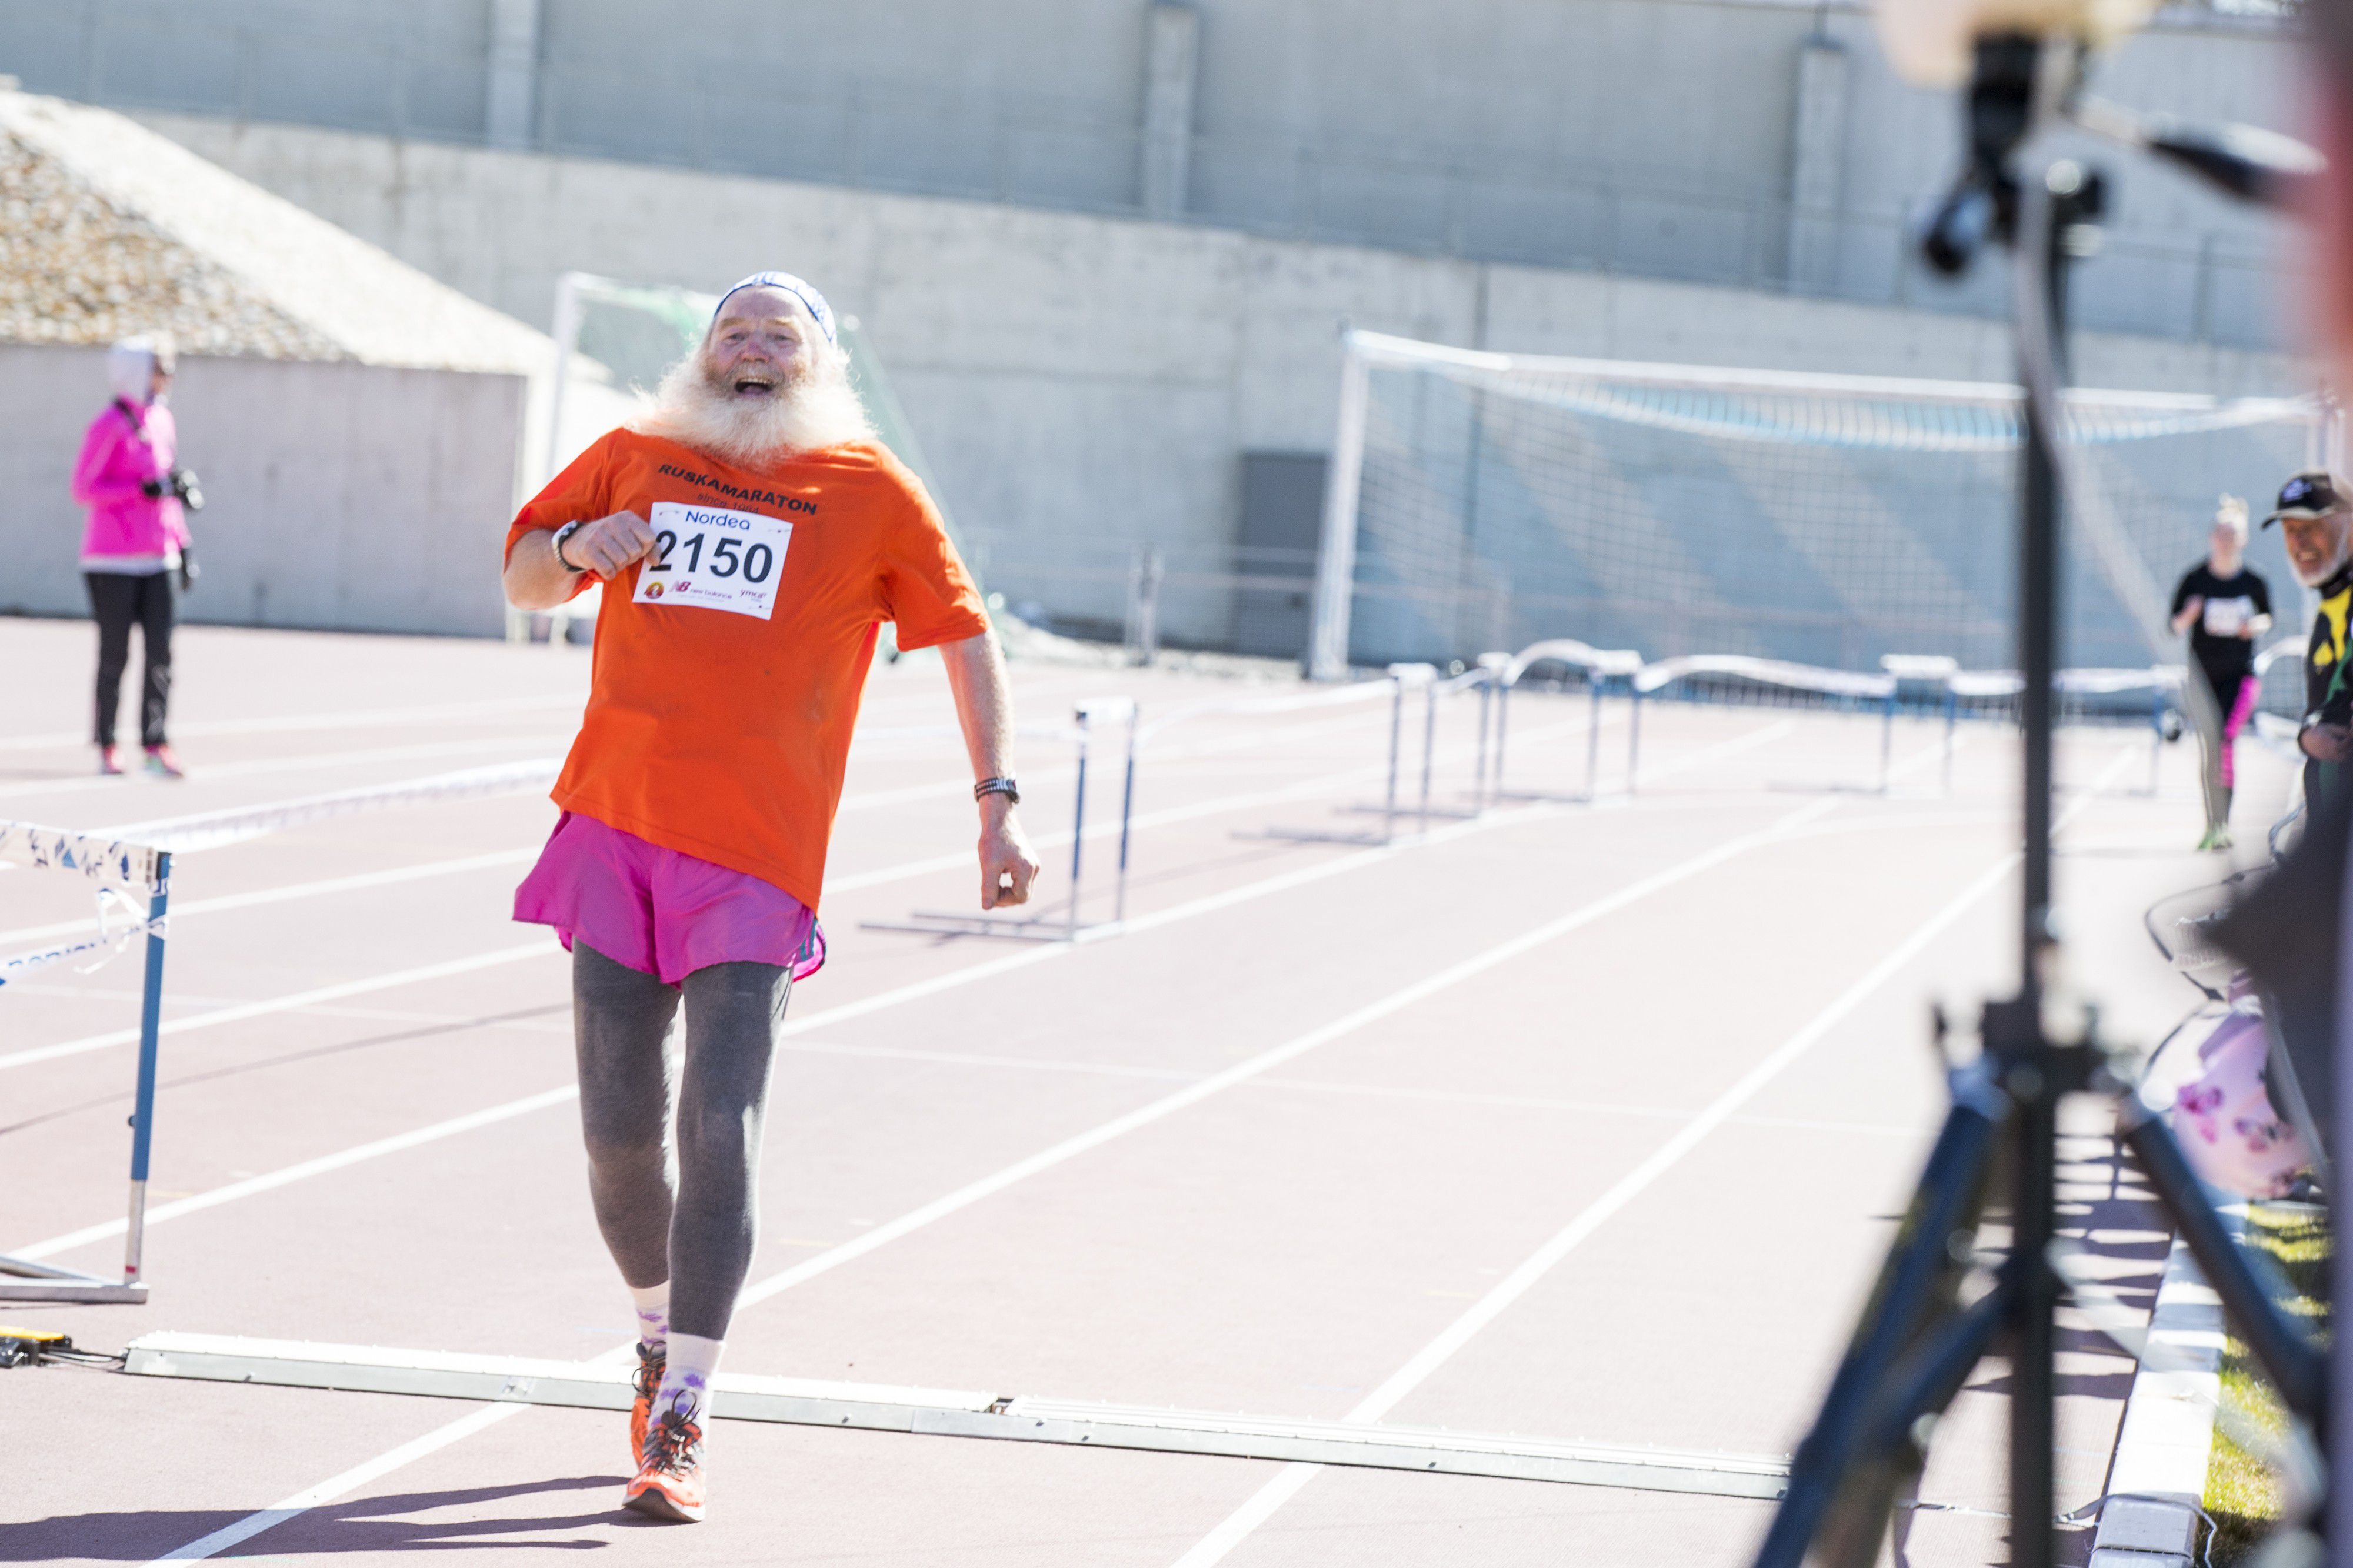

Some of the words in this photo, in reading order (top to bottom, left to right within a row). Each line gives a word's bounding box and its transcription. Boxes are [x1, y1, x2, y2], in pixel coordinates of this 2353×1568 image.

[658, 464, 818, 515] RUSKAMARATON
[685, 510, 751, 531] Nordea
[648, 529, 773, 583] 2150
[704, 589, 732, 599] balance
